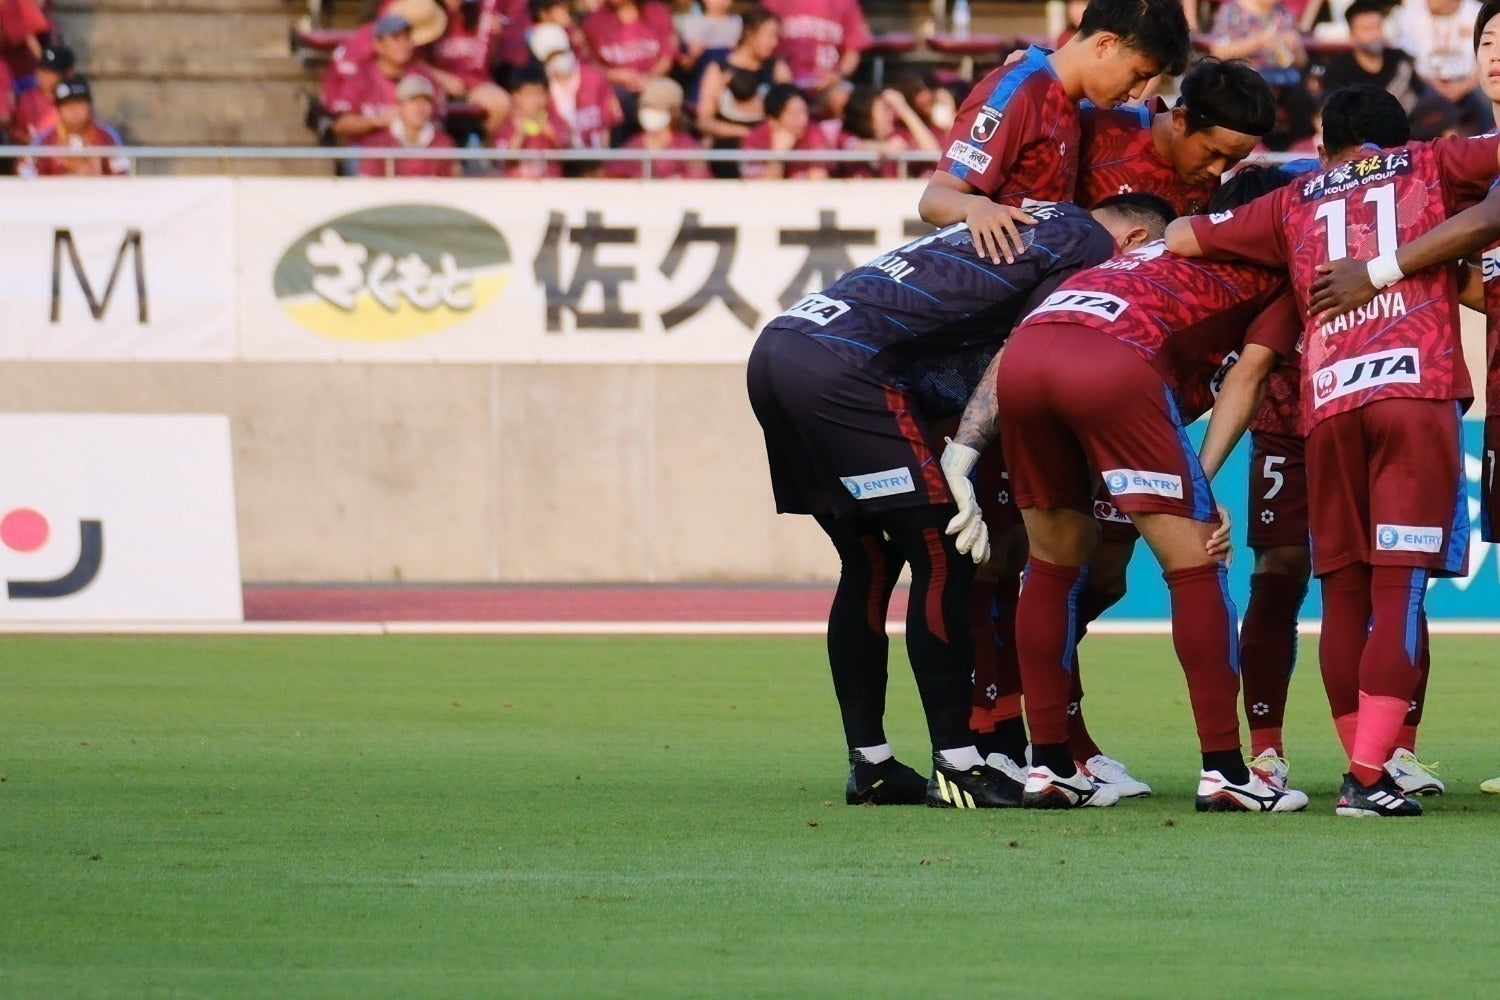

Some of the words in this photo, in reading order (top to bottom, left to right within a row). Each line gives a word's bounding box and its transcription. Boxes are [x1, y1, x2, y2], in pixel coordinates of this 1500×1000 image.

[1324, 180, 1359, 196] KOUWA
[1361, 170, 1396, 186] GROUP
[1313, 182, 1398, 262] 11
[49, 228, 150, 324] M
[306, 227, 478, 311] さくもと
[533, 207, 935, 333] 佐久本
[1049, 294, 1121, 315] JTA
[1342, 355, 1416, 387] JTA
[863, 474, 909, 491] ENTRY
[1133, 477, 1180, 491] ENTRY
[1262, 455, 1286, 499] 5
[1404, 534, 1442, 546] ENTRY
